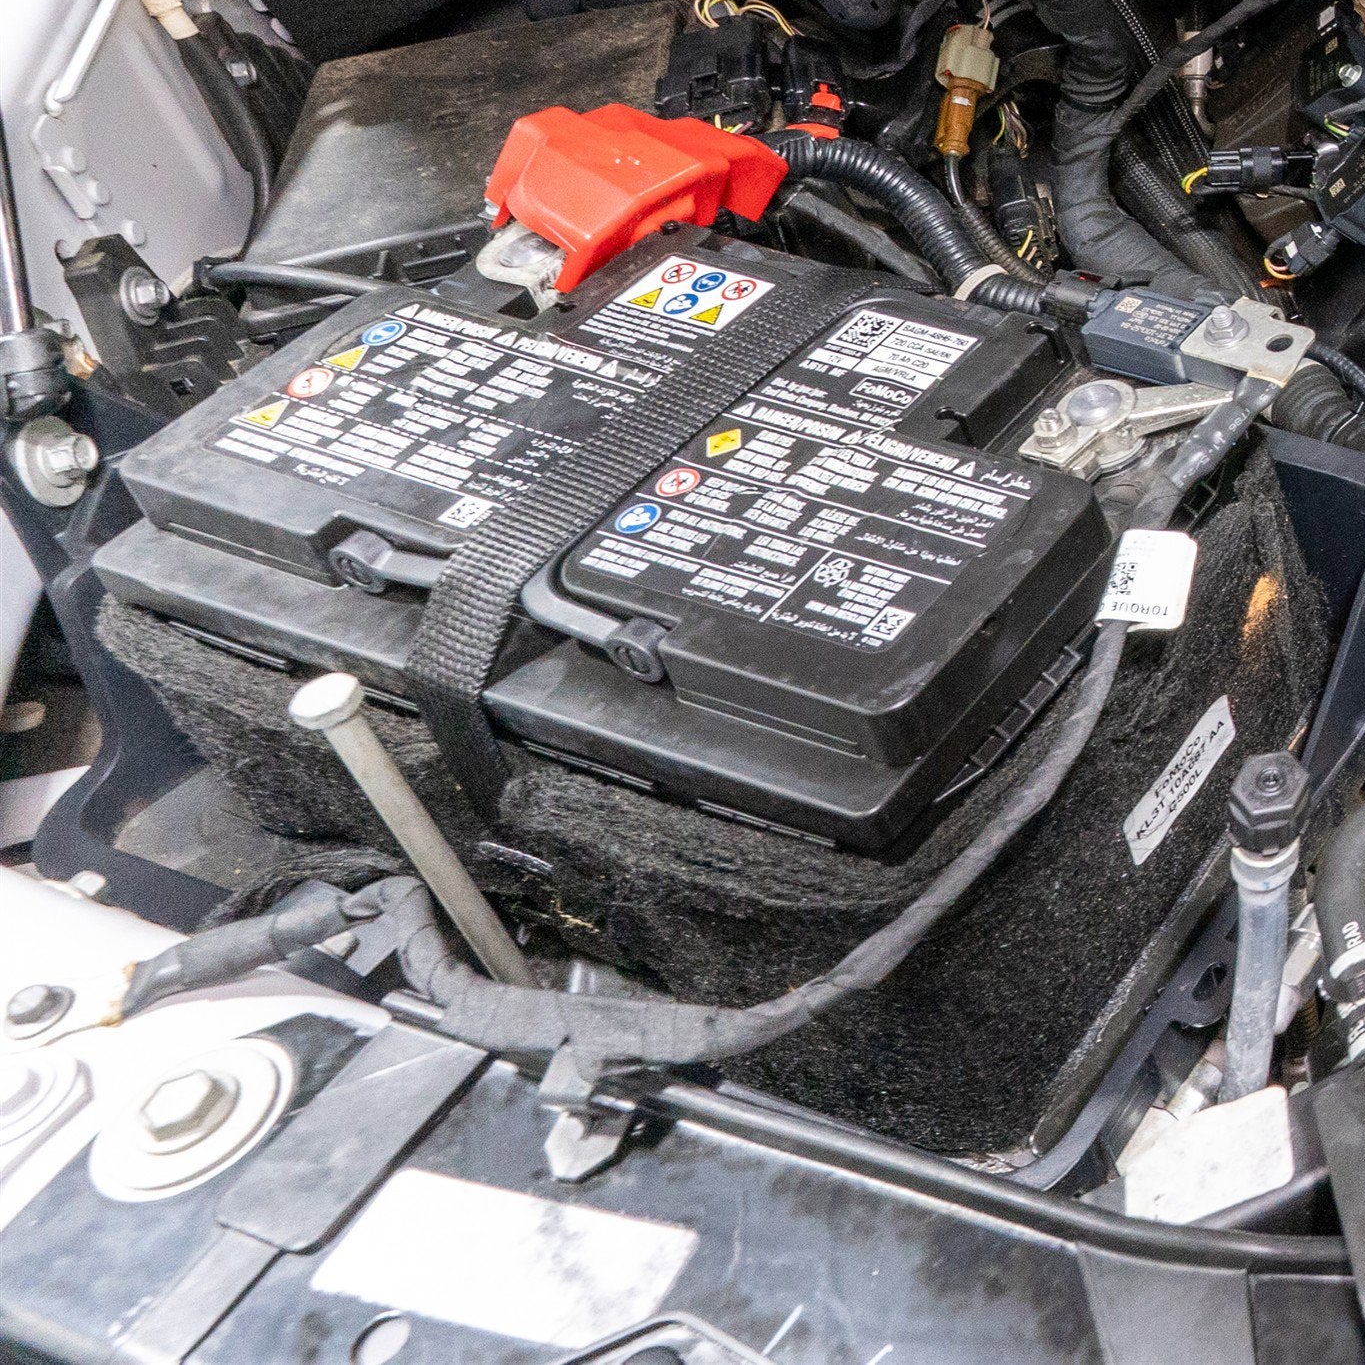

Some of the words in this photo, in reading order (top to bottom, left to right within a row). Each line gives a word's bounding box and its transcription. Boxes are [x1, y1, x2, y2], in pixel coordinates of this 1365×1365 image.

[855, 382, 914, 404] FoMoCo
[1109, 600, 1169, 617] TORQUE
[1133, 798, 1167, 840] KL3T
[1205, 720, 1225, 743] AA
[1152, 734, 1202, 798] FoMoCo
[1341, 920, 1364, 950] RAD
